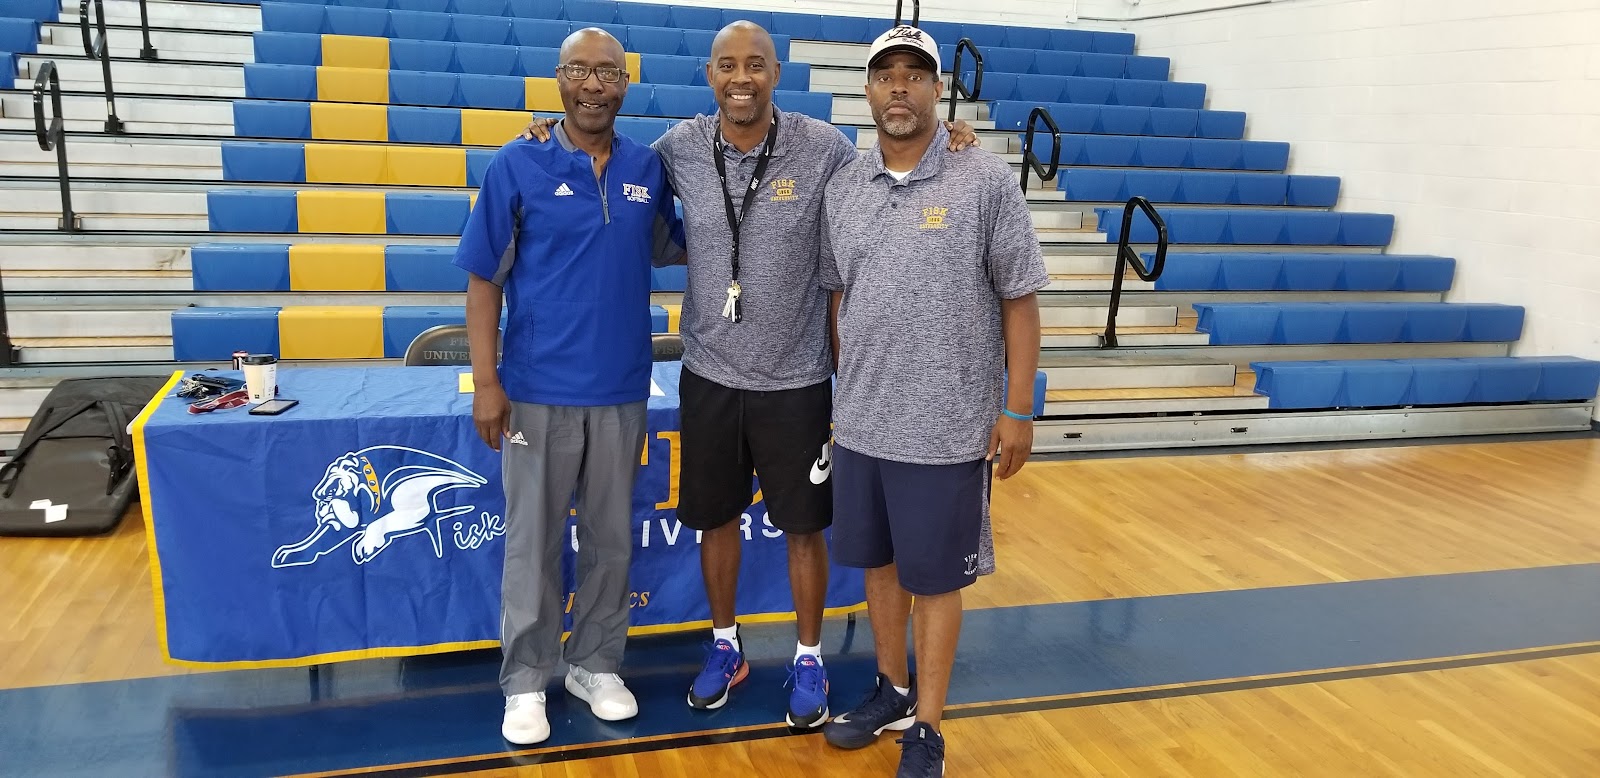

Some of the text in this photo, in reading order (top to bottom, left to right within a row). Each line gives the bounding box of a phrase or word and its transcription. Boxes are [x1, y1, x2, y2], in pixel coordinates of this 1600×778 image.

[886, 26, 923, 41] Fisk
[770, 179, 796, 189] FISK
[622, 183, 652, 199] FISK
[922, 207, 949, 217] FISK
